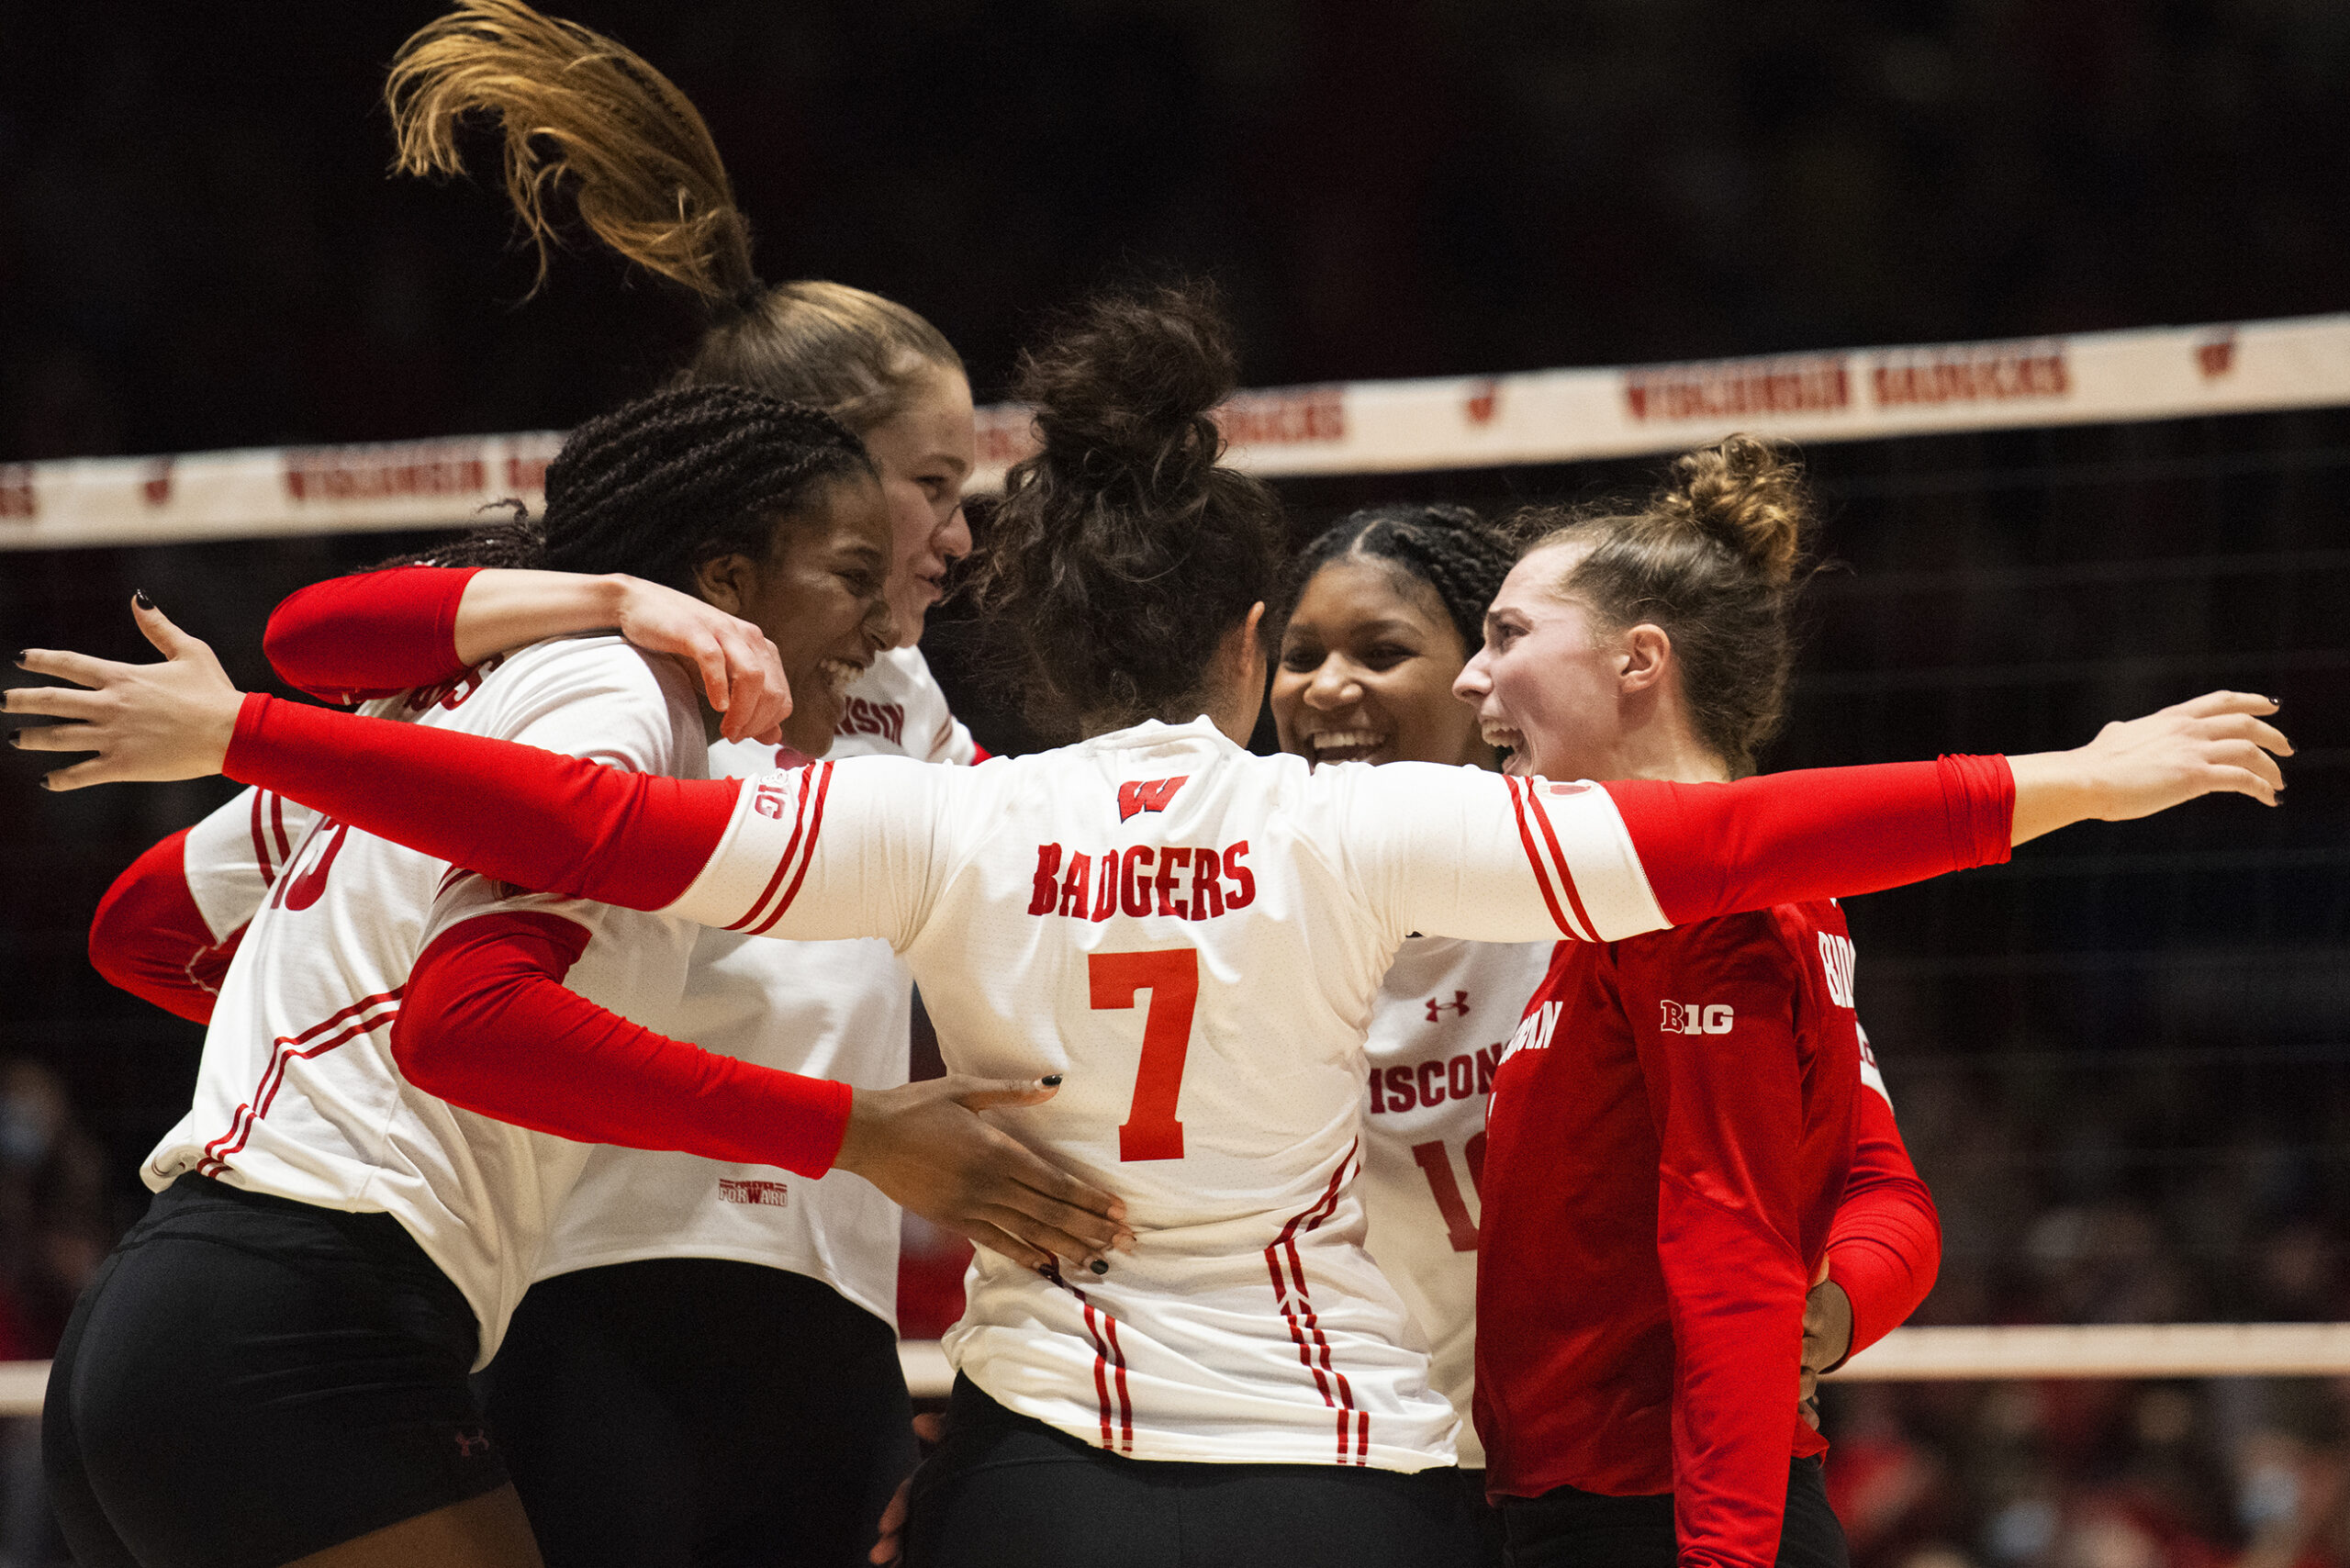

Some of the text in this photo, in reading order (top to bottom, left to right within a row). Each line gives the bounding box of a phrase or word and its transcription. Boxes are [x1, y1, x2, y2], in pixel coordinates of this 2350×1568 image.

[1117, 775, 1190, 824] W
[1027, 840, 1257, 923] BADGERS
[1088, 948, 1199, 1162] 7
[1370, 1043, 1503, 1114] ISCON
[718, 1186, 788, 1207] FORWARD
[1412, 1130, 1487, 1252] 1
